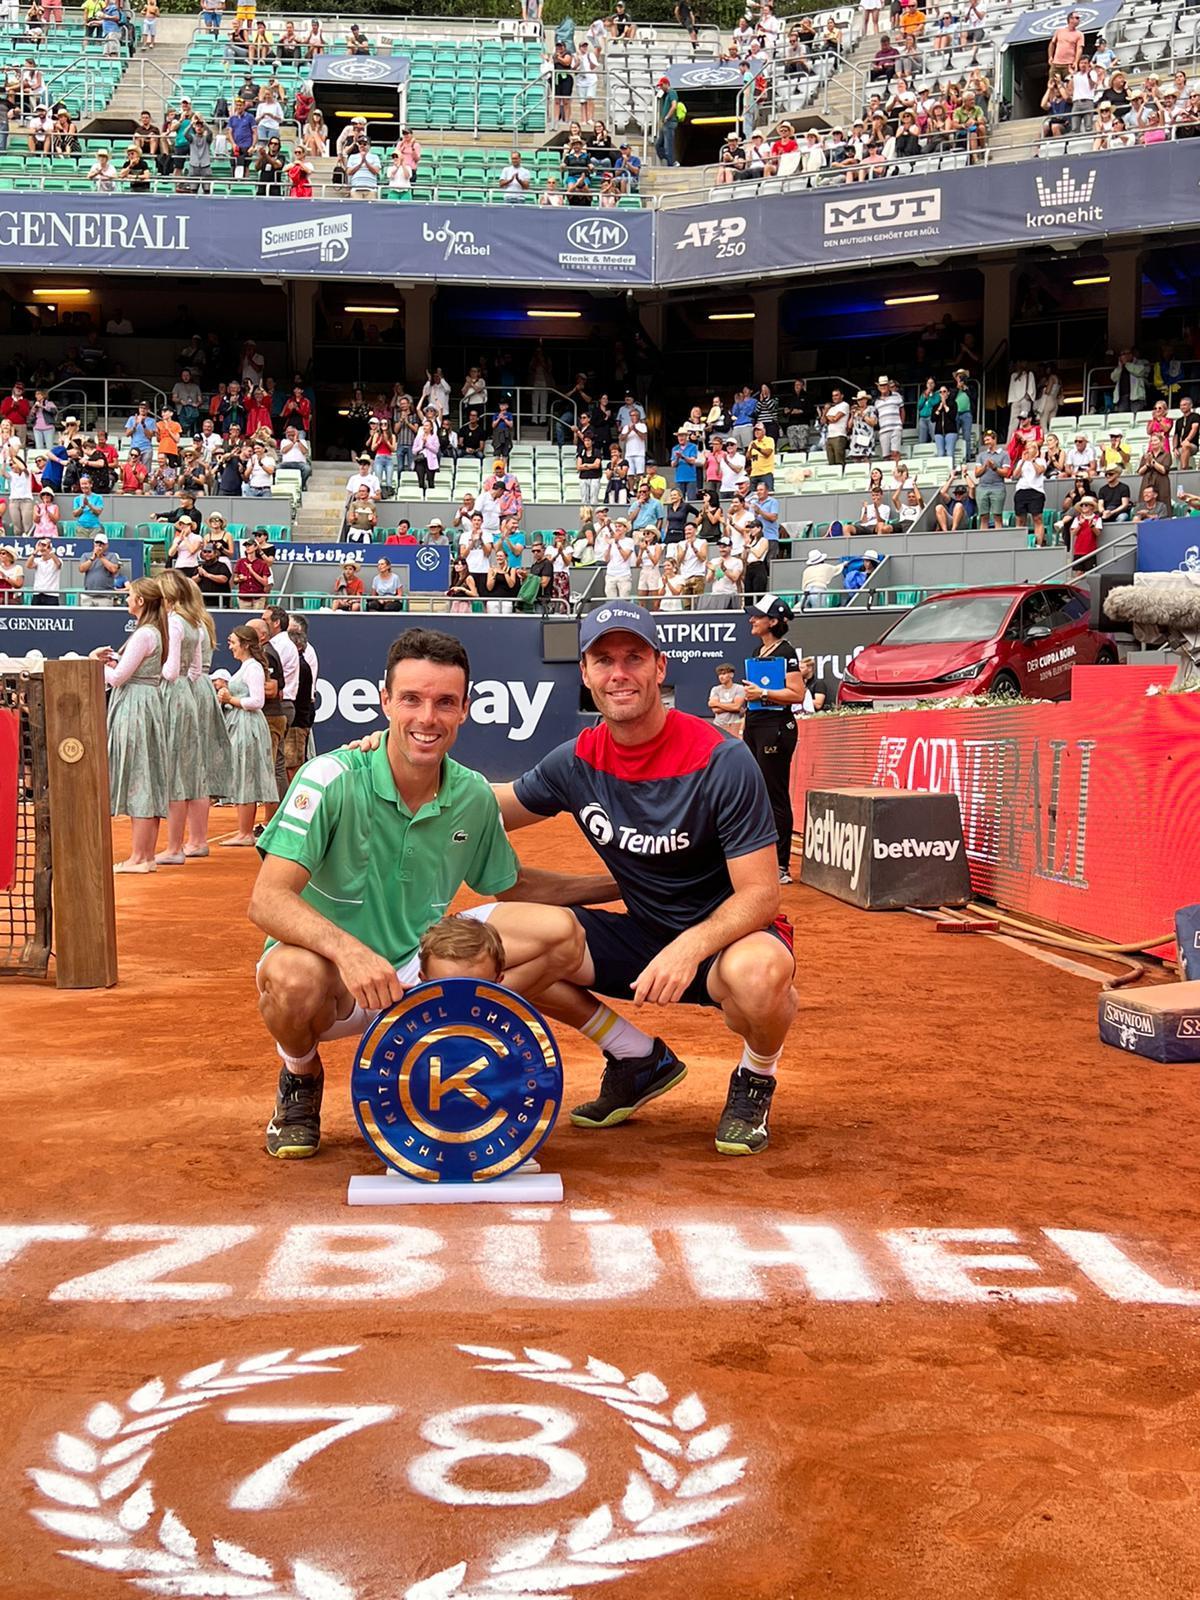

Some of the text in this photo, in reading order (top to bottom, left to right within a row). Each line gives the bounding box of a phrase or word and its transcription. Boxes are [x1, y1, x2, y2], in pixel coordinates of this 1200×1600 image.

[830, 195, 935, 227] MUT
[1026, 206, 1103, 228] kronehit
[0, 210, 190, 250] GENERALI
[265, 222, 348, 245] SCHNEIDER TENNIS
[673, 216, 746, 250] ATP
[824, 227, 940, 248] DEN MUTIGEN GEHÖRT DER MÜLL
[454, 243, 490, 256] Kabel
[603, 256, 632, 264] Meder
[715, 241, 746, 259] 250
[8, 618, 74, 632] GENERALI
[612, 609, 640, 620] Tennis
[314, 670, 555, 742] beay
[618, 825, 691, 855] Tennis
[804, 799, 867, 891] betway
[873, 838, 960, 862] betway
[222, 1402, 592, 1512] 78
